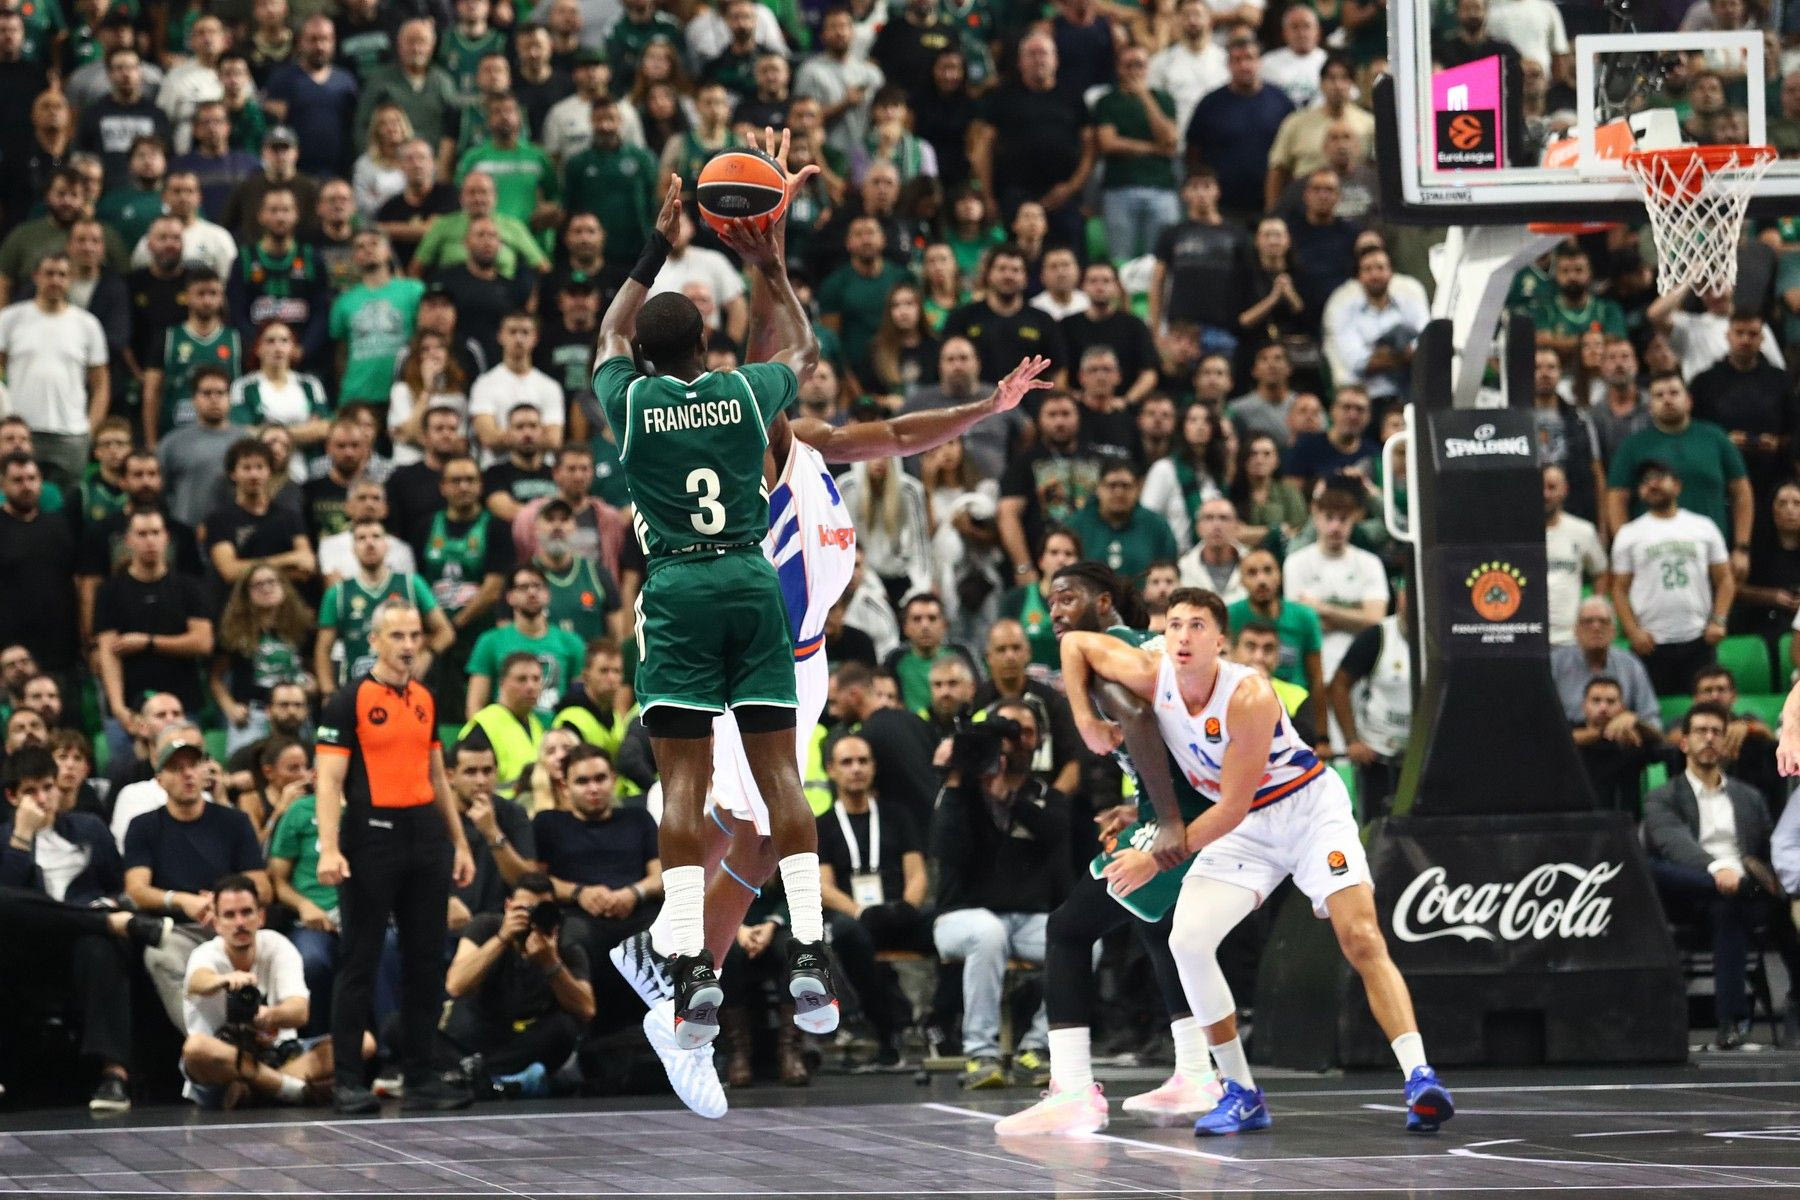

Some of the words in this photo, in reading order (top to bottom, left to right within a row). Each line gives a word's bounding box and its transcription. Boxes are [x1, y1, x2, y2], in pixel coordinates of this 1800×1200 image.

[643, 399, 742, 434] FRANCISCO
[1445, 435, 1530, 459] SPALDING
[685, 467, 727, 536] 3
[1392, 861, 1624, 942] Coca-Cola
